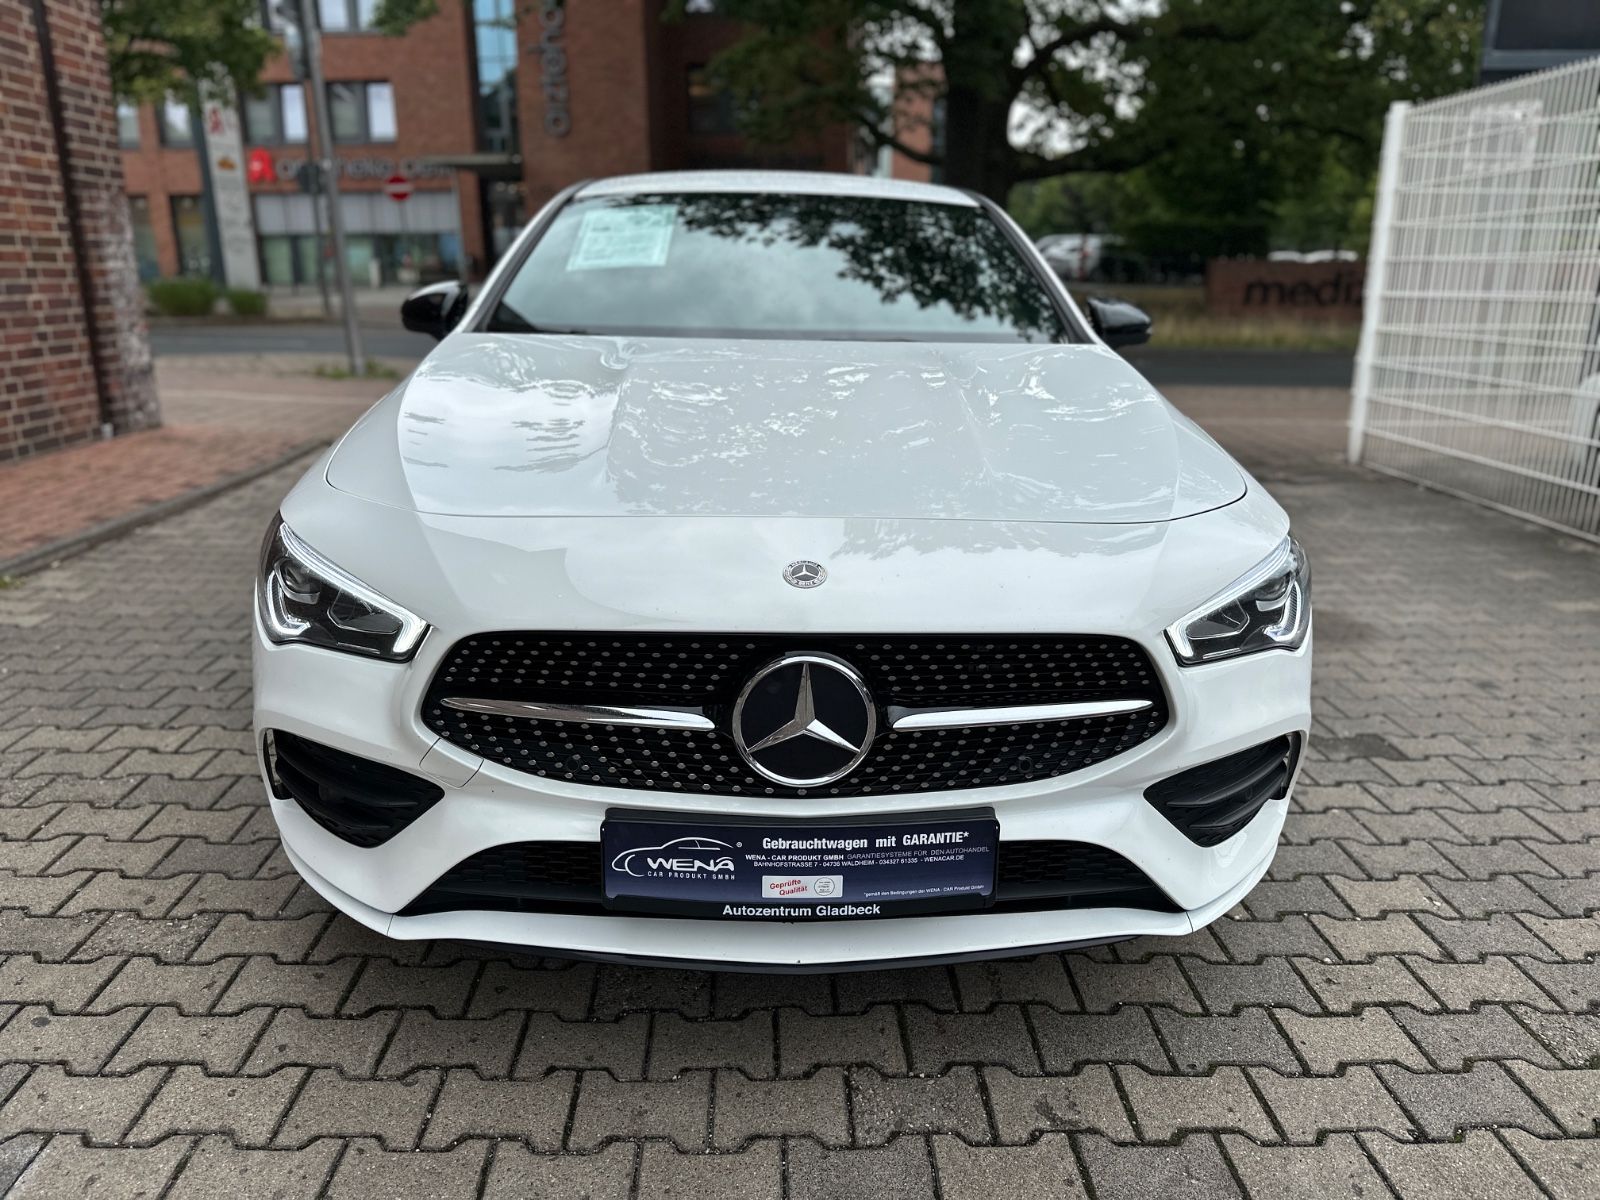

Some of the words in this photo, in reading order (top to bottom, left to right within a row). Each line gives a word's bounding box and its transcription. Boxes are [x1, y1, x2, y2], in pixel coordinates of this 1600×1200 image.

[762, 837, 868, 851] Gebrauchtwagen
[875, 836, 897, 848] mit
[847, 850, 913, 860] GARANTIESYSTEME
[945, 846, 990, 854] AUTOHANDEL
[646, 857, 735, 872] WENA
[841, 859, 875, 867] WALDHEIM
[668, 872, 707, 880] PRODUKT
[769, 879, 802, 890] Geprüfte
[779, 885, 808, 896] Qualität
[722, 904, 812, 917] Autozentrum
[815, 904, 881, 917] Gladbeck
